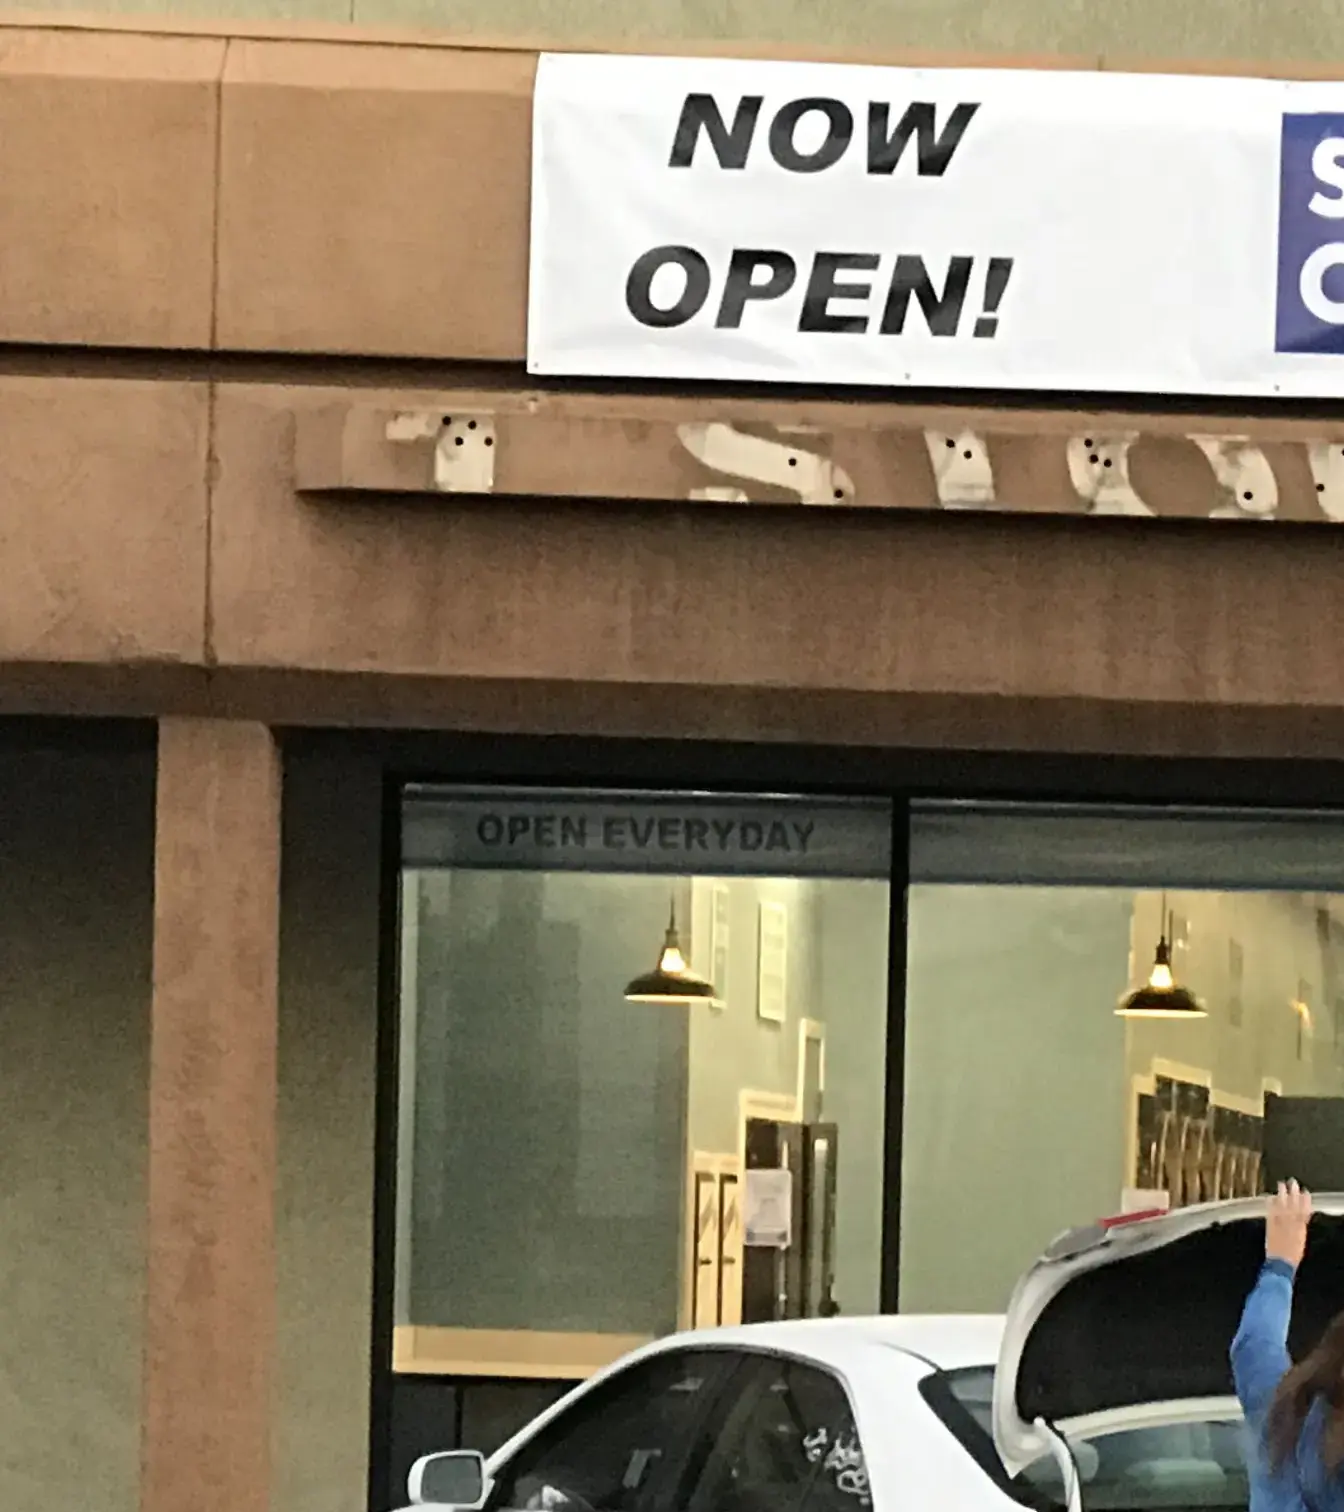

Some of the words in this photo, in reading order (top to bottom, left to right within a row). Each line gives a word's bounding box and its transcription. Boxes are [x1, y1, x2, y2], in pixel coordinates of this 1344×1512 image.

[668, 92, 981, 178] NOW
[624, 244, 1014, 339] OPEN!
[476, 814, 587, 848] OPEN
[601, 816, 815, 853] EVERYDAY
